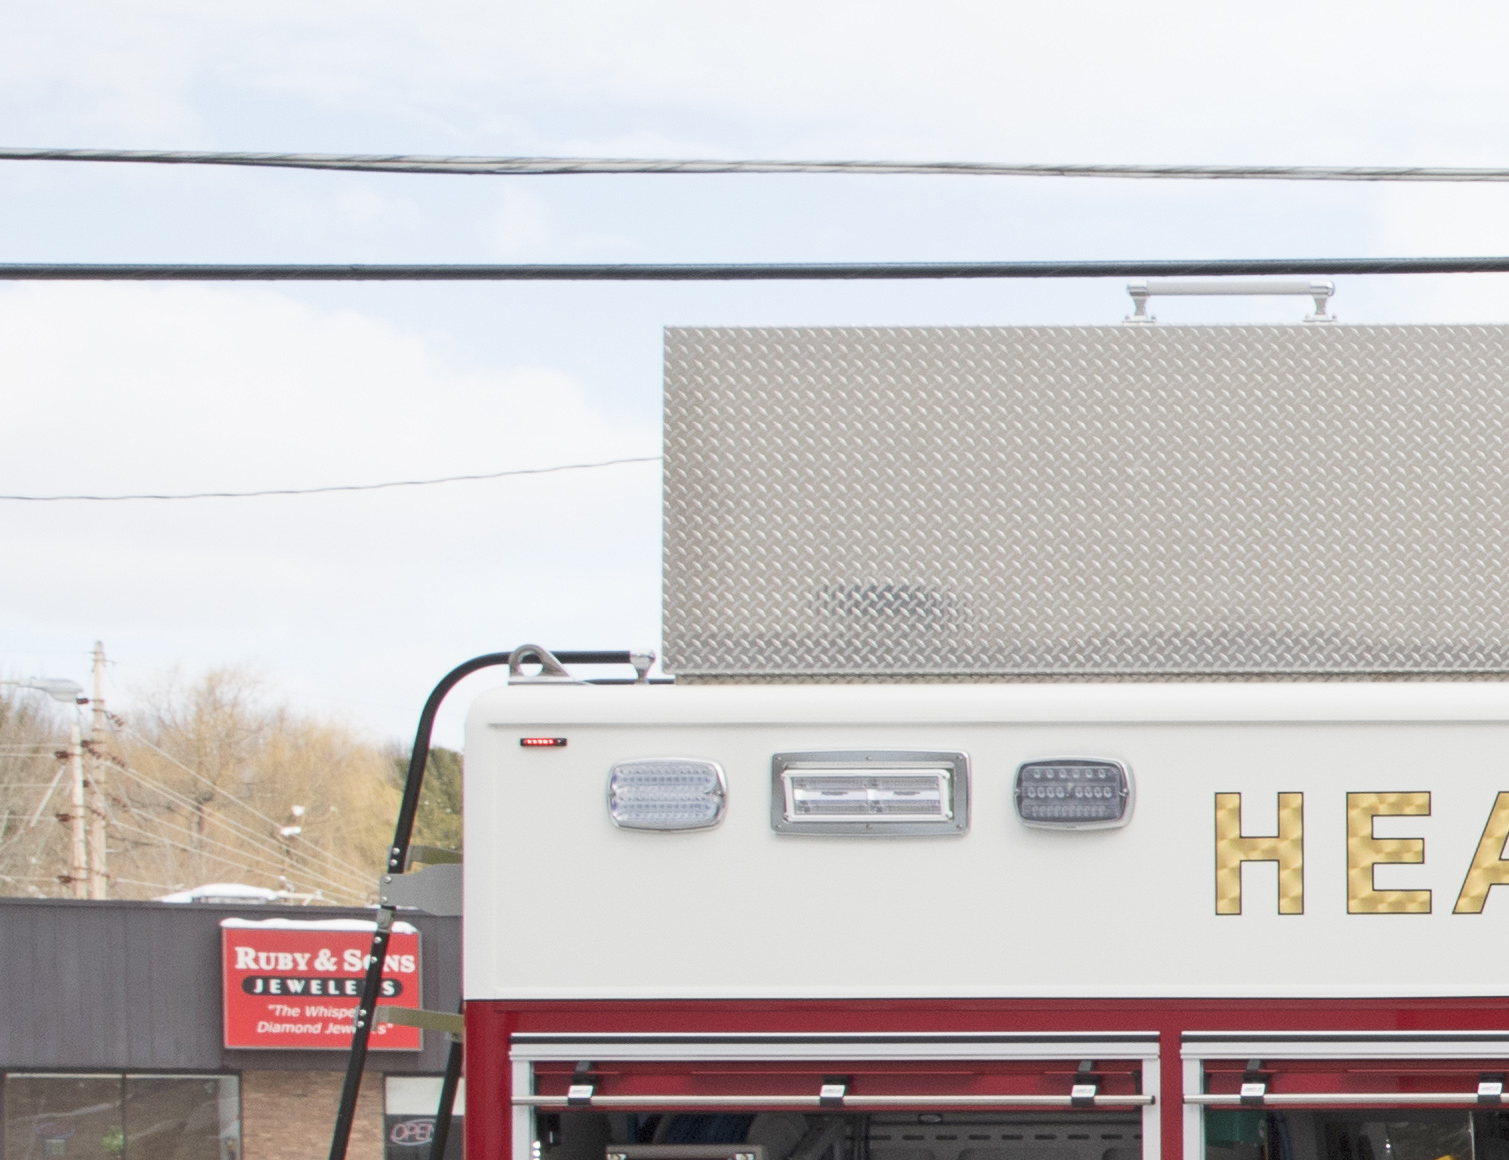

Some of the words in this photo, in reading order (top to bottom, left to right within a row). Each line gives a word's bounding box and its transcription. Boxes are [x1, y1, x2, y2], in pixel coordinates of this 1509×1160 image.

[234, 947, 311, 970] RUBY
[314, 948, 337, 971] &
[253, 979, 395, 996] JEWELES
[257, 1021, 321, 1034] Diamond
[391, 1123, 434, 1142] OPE
